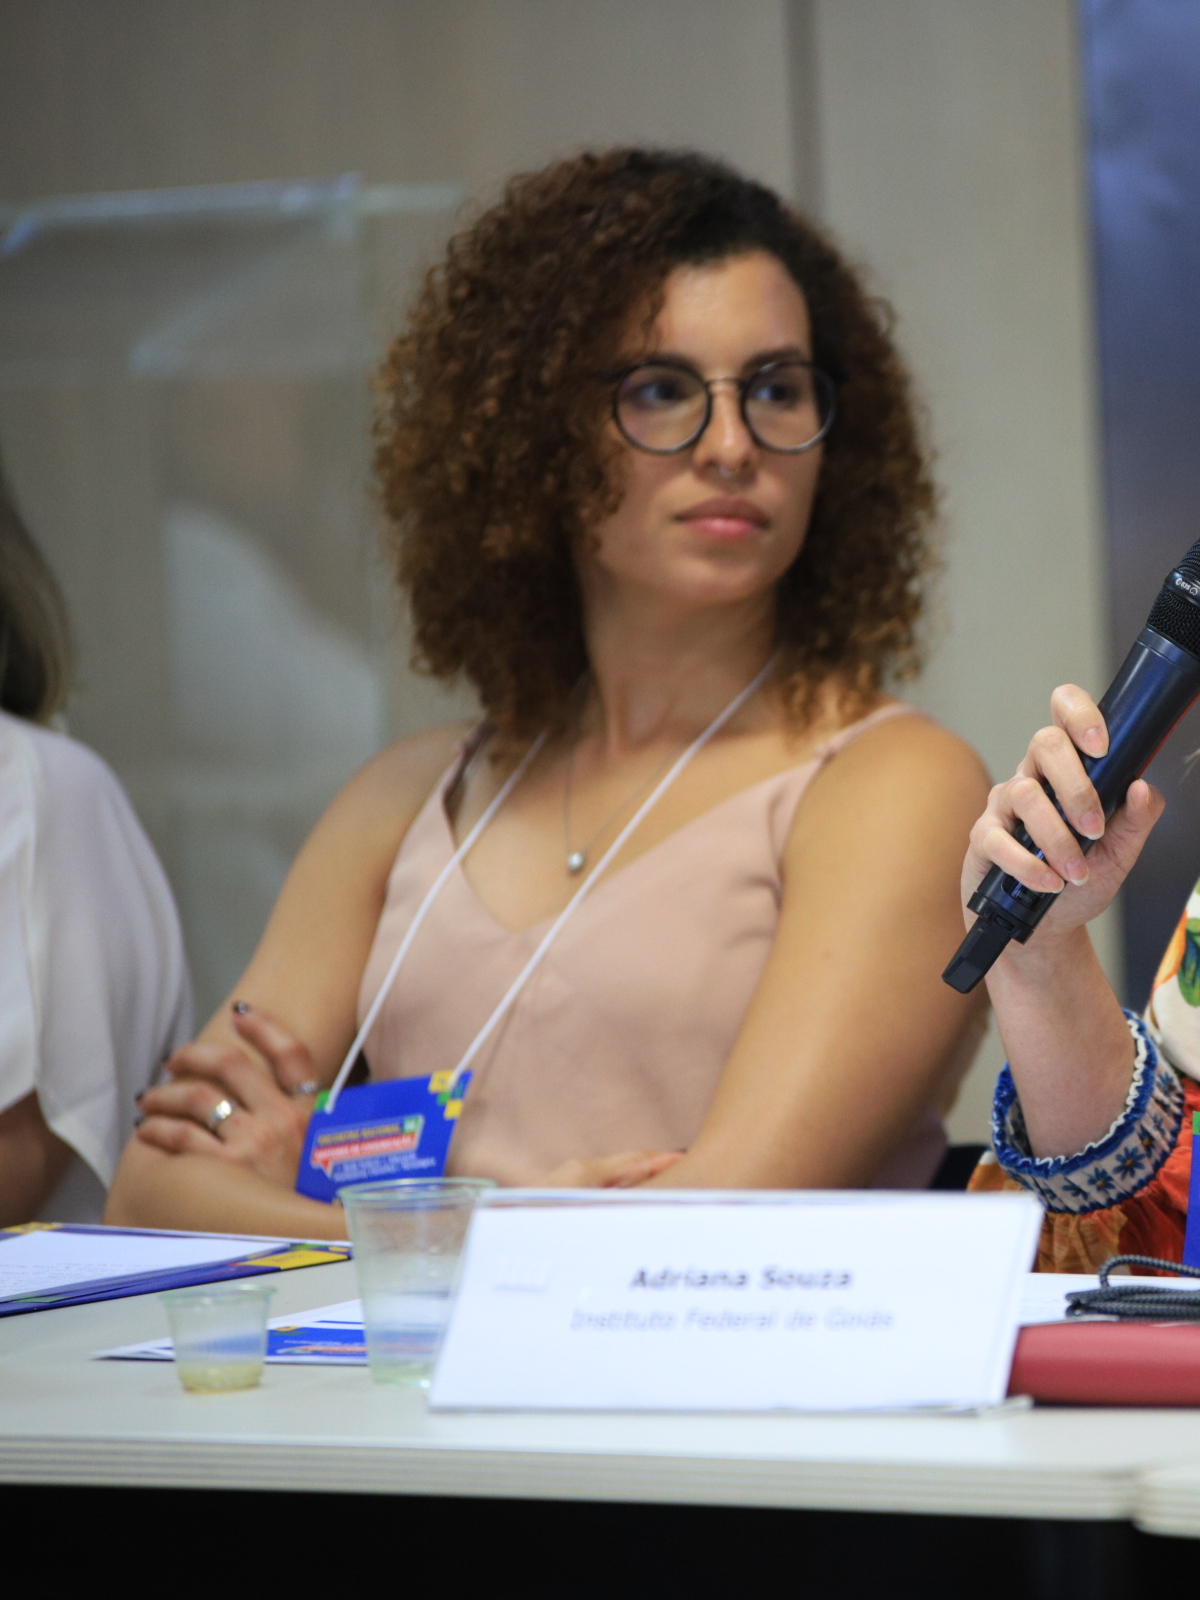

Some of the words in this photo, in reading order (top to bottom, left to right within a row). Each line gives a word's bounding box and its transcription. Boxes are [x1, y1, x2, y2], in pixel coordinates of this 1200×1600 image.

[631, 1265, 750, 1291] Adriana
[760, 1266, 854, 1291] Souza
[569, 1307, 677, 1332] Instituto
[683, 1306, 778, 1332] Federal
[785, 1308, 815, 1332] de
